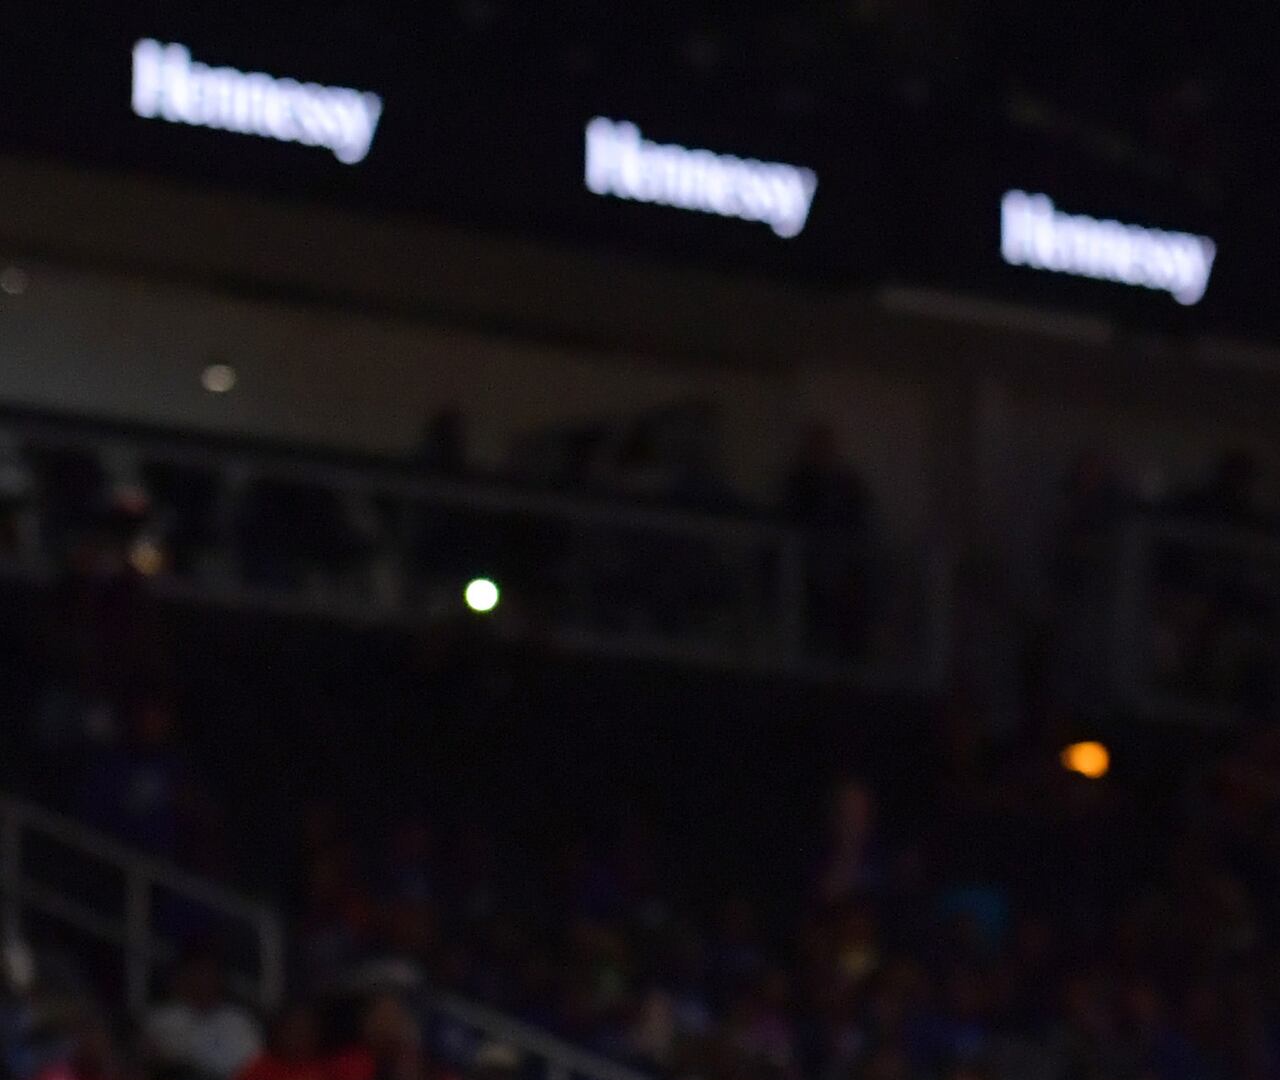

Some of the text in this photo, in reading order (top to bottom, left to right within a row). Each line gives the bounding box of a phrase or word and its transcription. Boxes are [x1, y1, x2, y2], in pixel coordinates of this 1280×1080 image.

[130, 37, 382, 164] Hennessy
[584, 116, 817, 239] Hennessy
[1001, 190, 1216, 306] Hennessy
